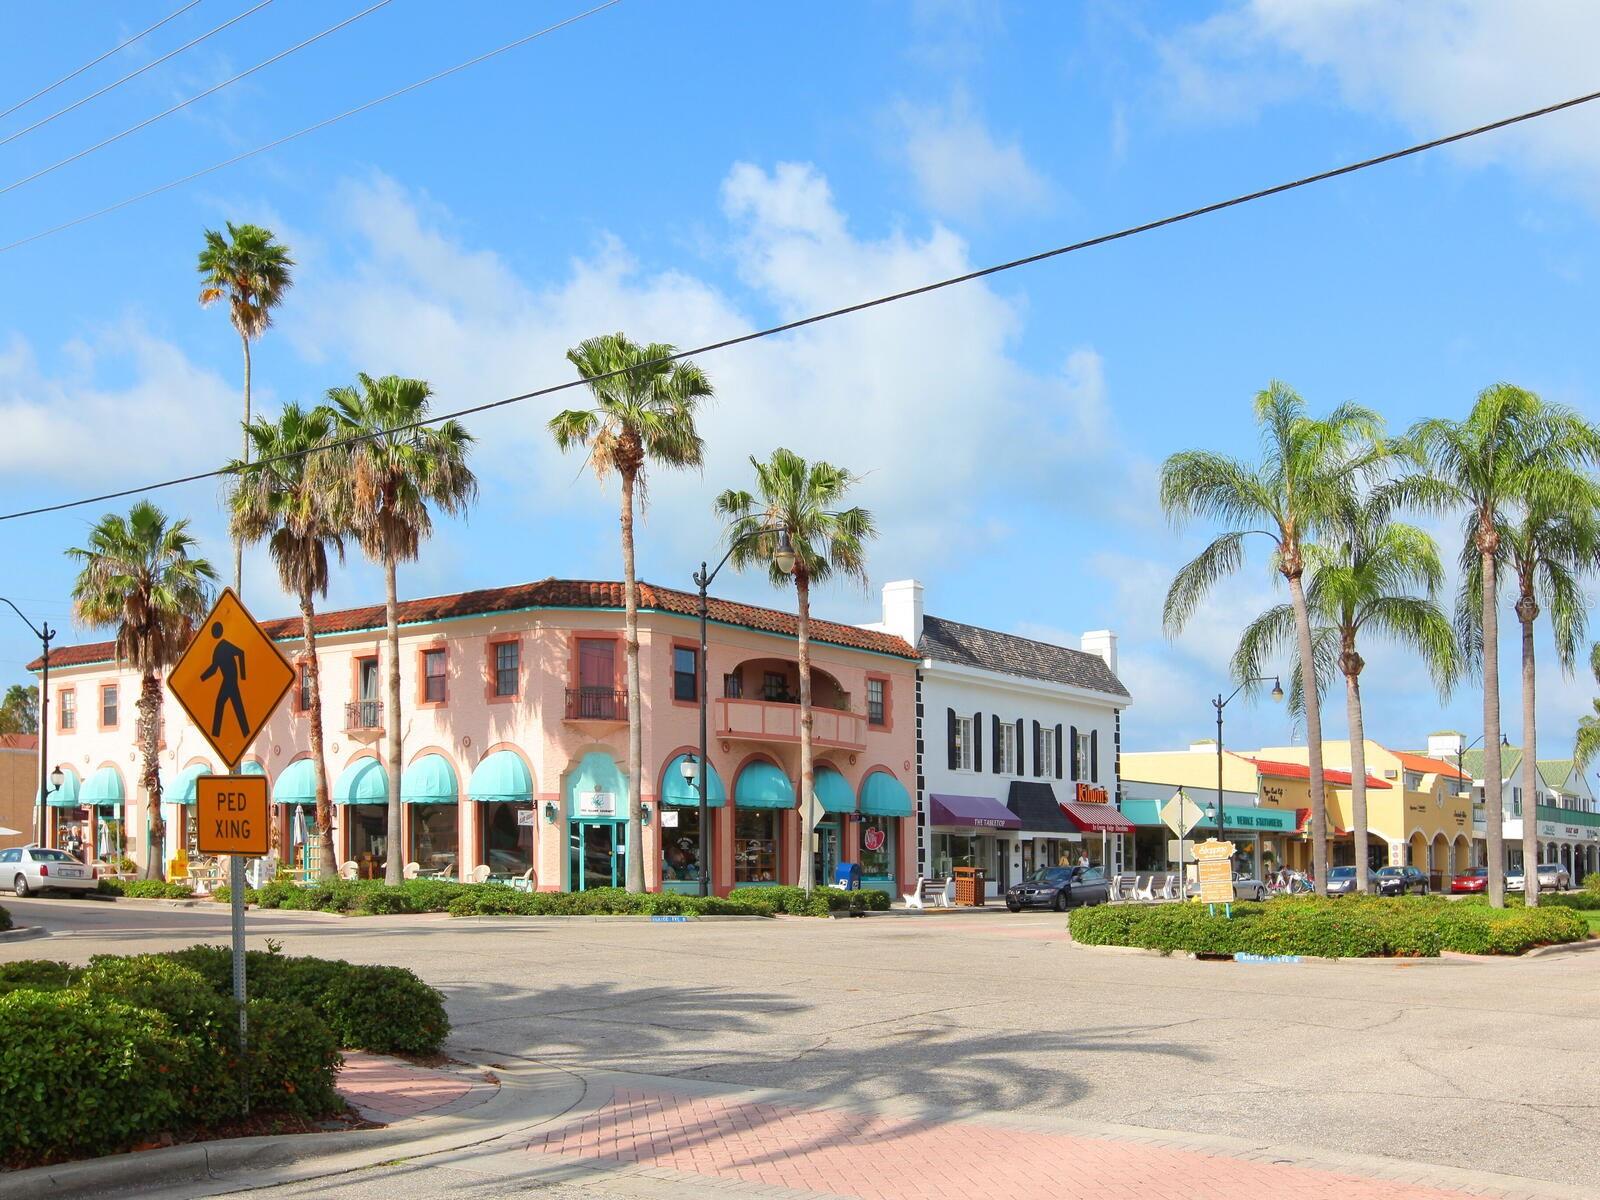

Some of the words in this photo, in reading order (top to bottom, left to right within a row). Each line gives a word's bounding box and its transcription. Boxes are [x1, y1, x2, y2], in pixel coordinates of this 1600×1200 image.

[217, 792, 247, 812] PED
[1076, 783, 1108, 804] Kilwin's
[215, 819, 251, 839] XING
[974, 818, 983, 826] THE
[1236, 815, 1253, 826] VENICE
